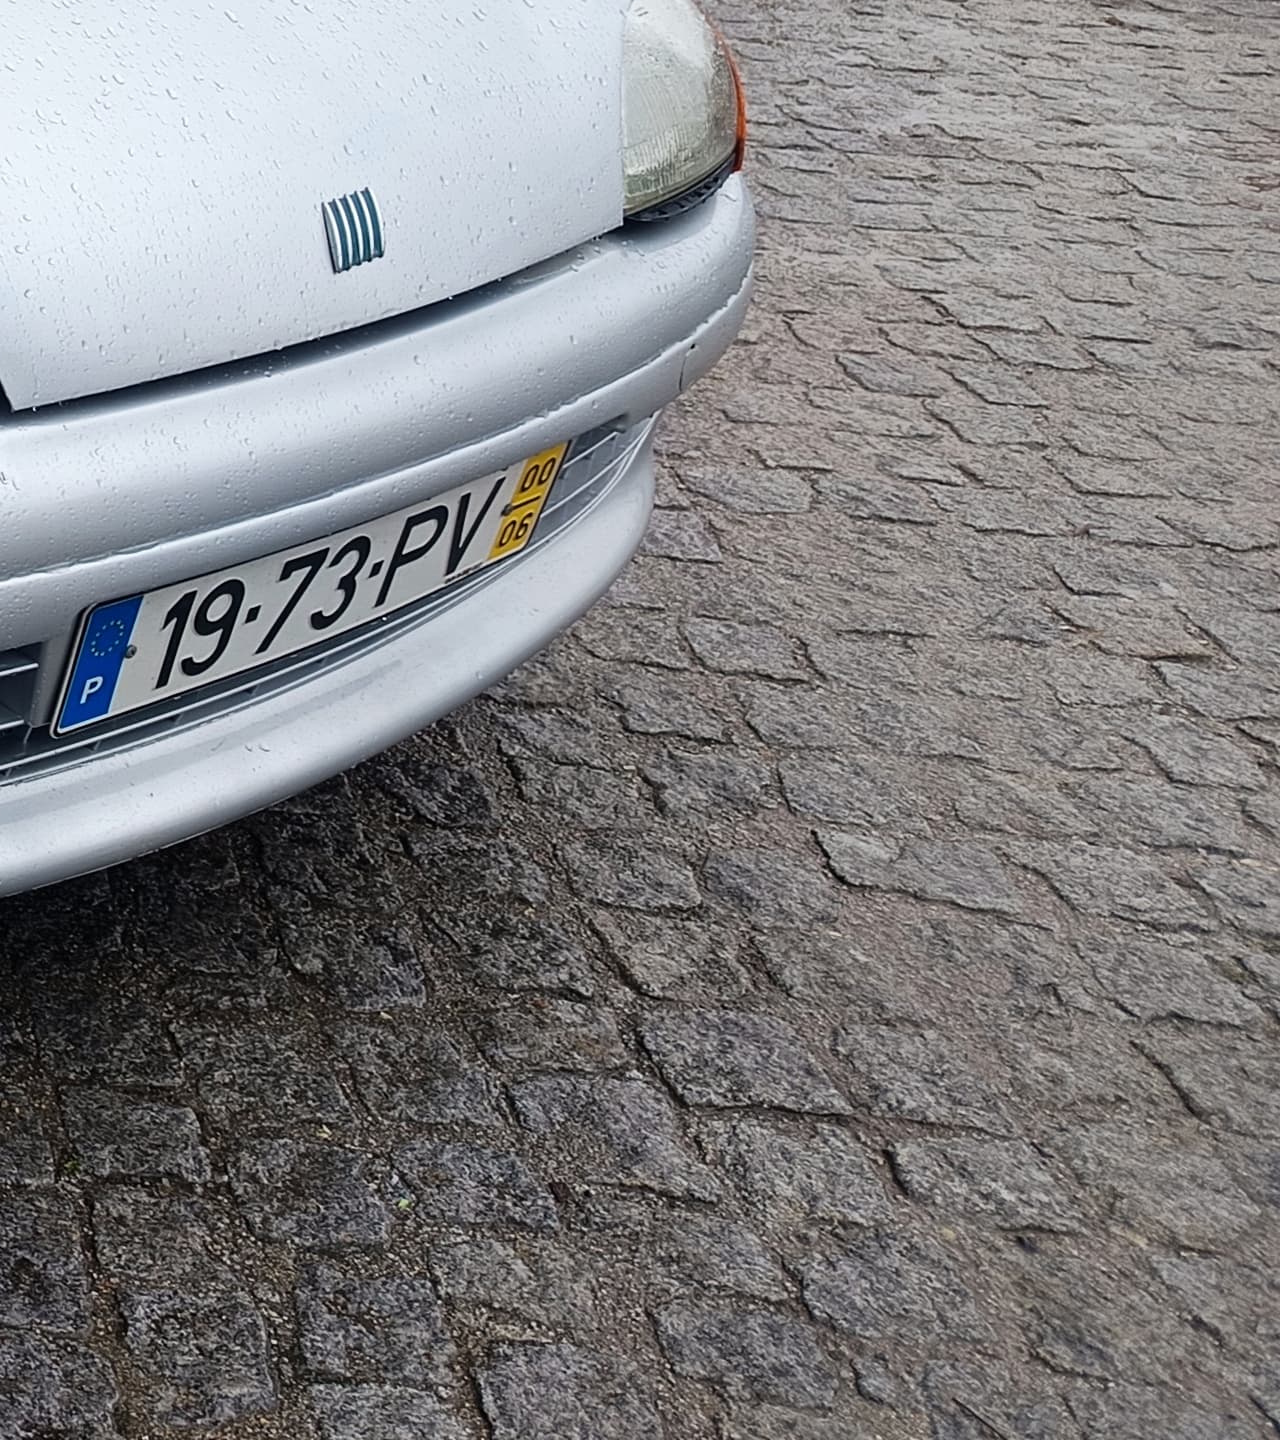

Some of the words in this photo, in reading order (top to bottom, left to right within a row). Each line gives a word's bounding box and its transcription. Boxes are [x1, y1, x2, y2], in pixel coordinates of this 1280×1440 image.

[520, 457, 557, 493] 00
[497, 512, 533, 548] 06
[79, 676, 104, 705] P
